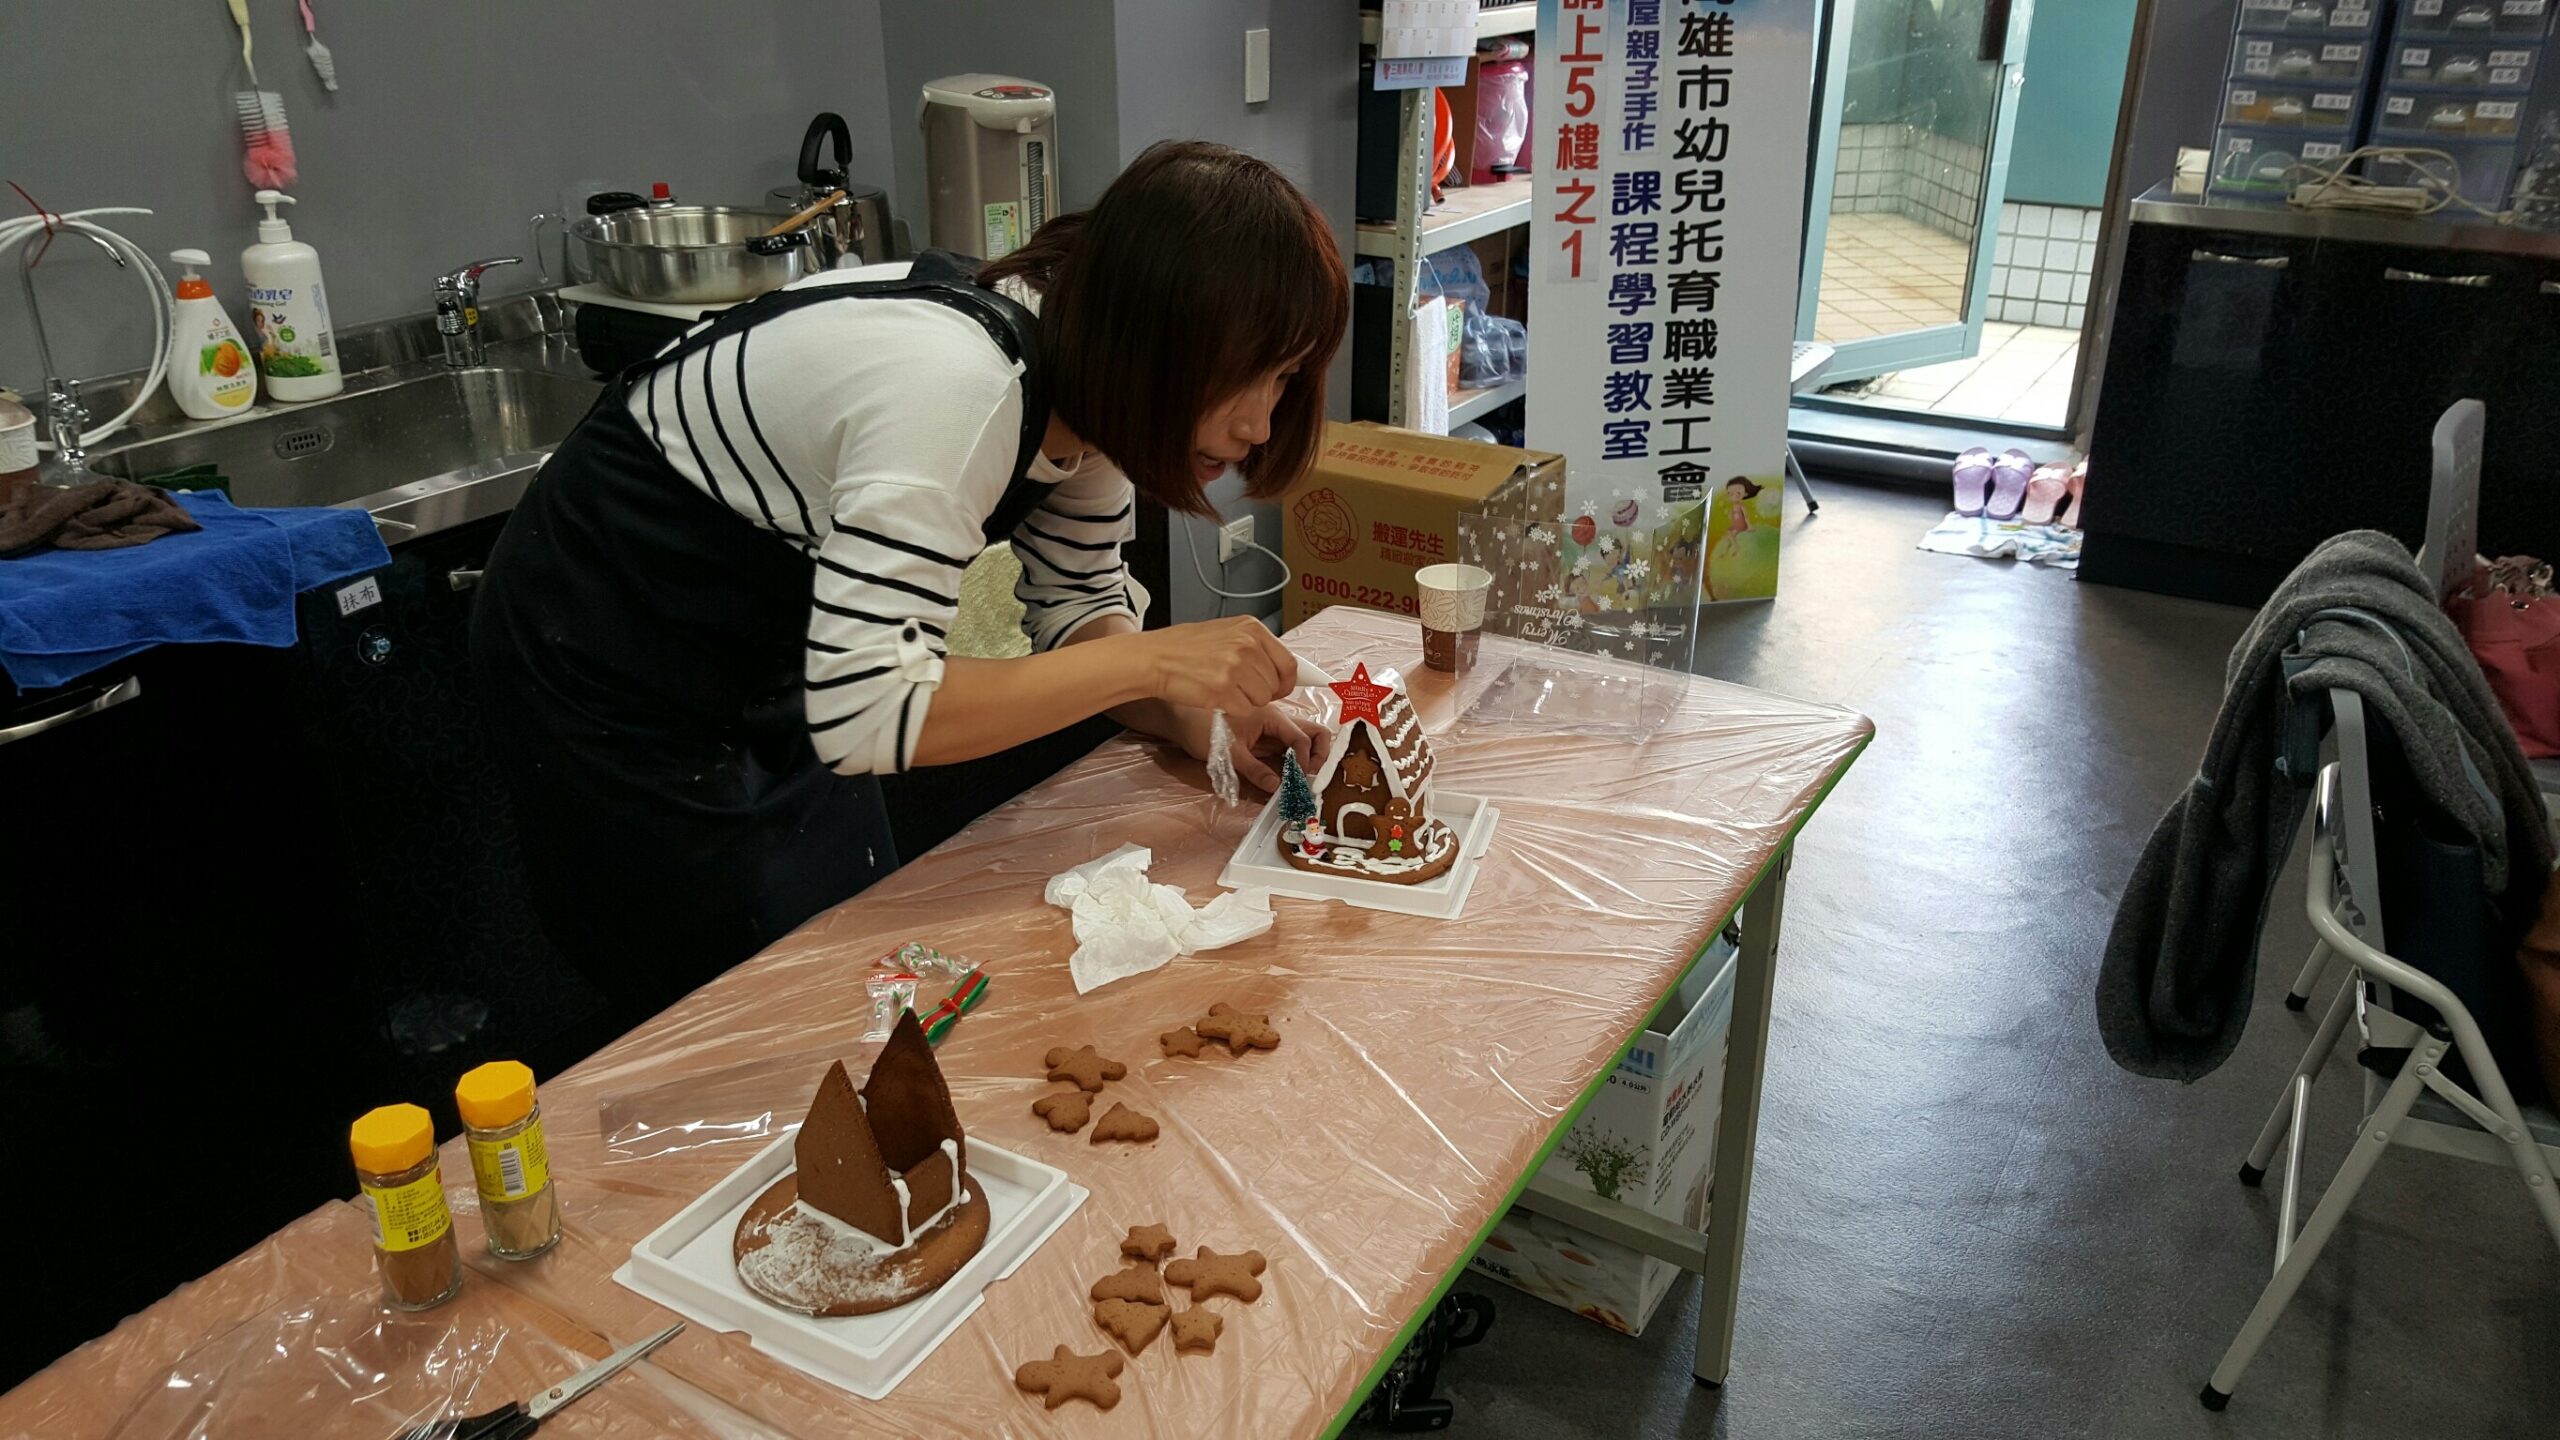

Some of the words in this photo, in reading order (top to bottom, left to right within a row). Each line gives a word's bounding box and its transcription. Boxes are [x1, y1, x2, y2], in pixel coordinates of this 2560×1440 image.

[1621, 0, 1660, 151] 屋親子手作
[1657, 0, 1735, 504] 雄市幼兒托育職業工會
[1602, 170, 1661, 460] 課程學習教室
[1372, 521, 1445, 556] 搬運先生
[343, 585, 375, 611] 抹布
[1521, 622, 1571, 646] Merry
